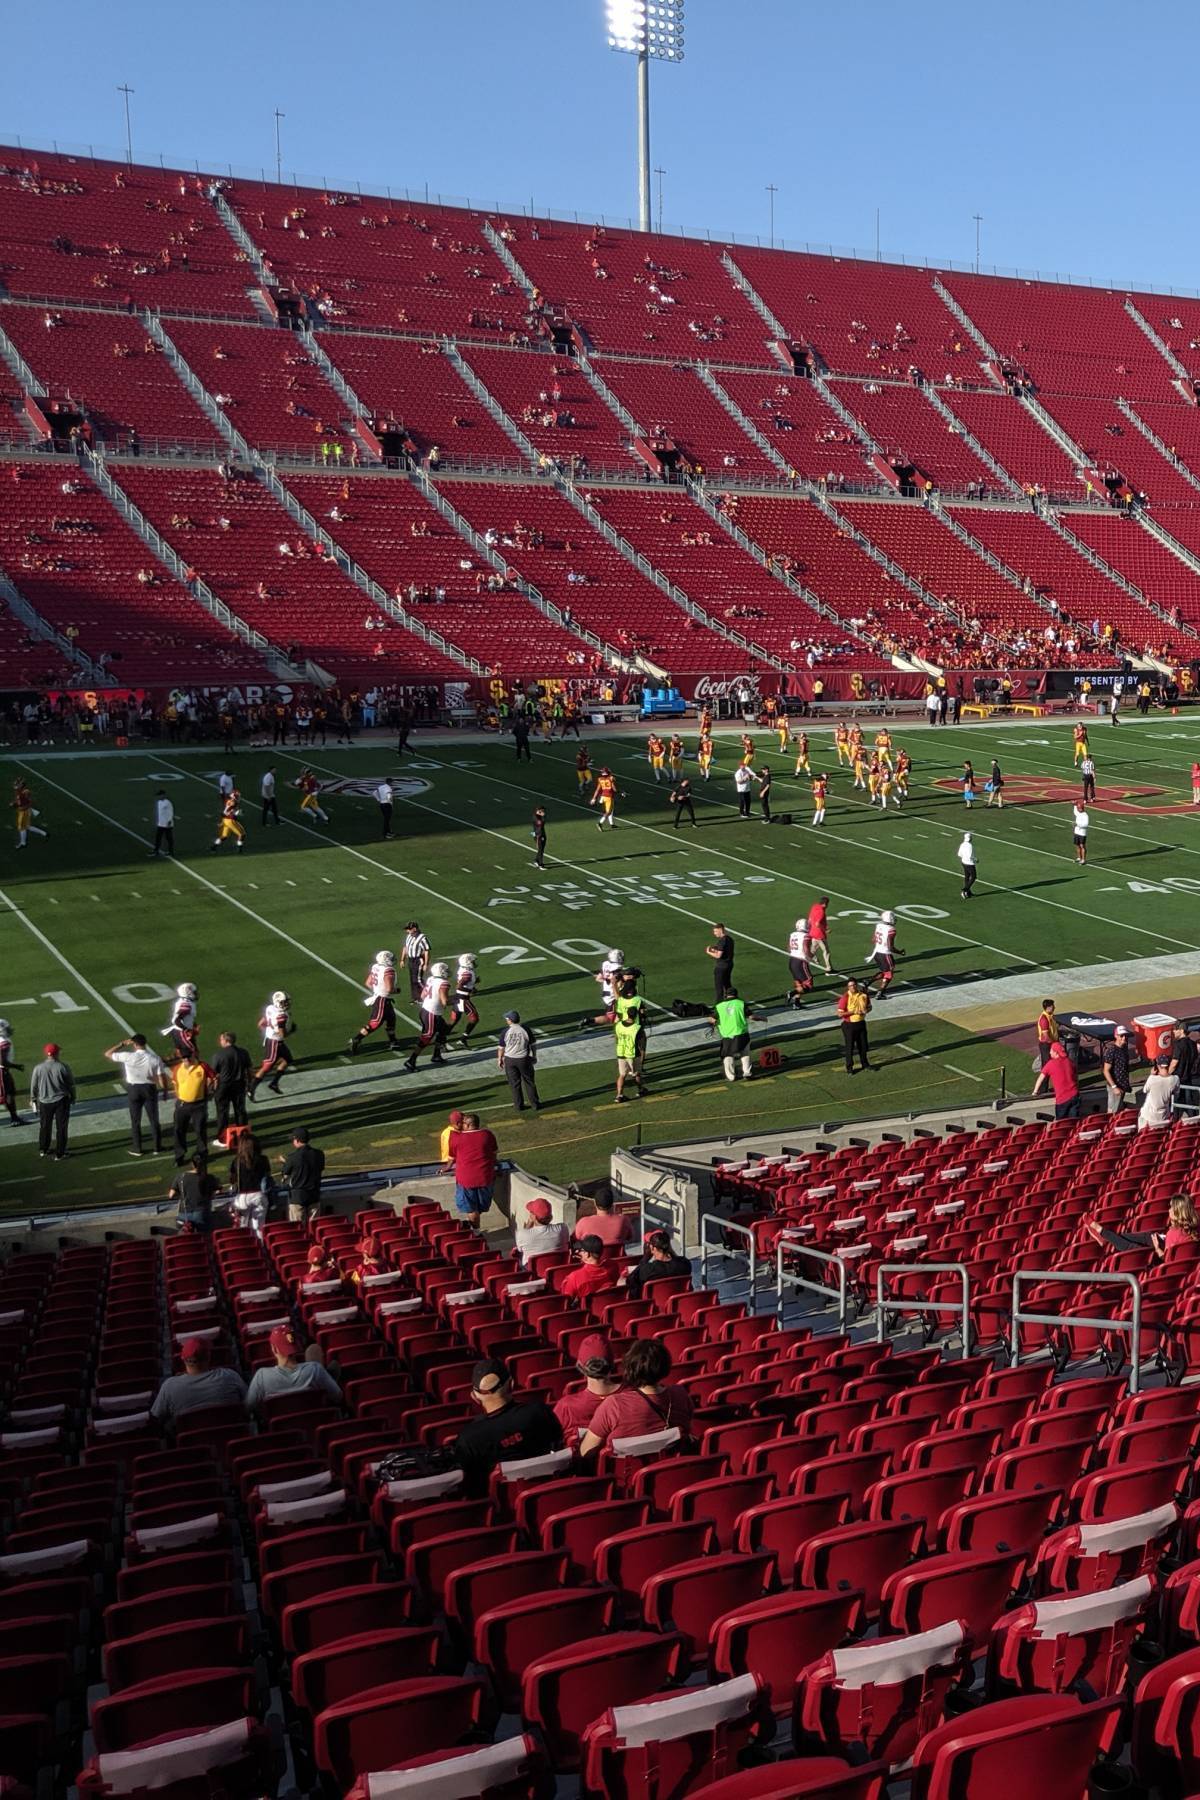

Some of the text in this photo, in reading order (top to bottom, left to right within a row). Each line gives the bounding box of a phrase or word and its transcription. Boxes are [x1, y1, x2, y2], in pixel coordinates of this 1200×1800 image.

[1074, 676, 1139, 686] PRESENTED BY
[837, 904, 951, 925] 30
[479, 938, 613, 965] 20
[41, 983, 177, 1013] 10
[764, 1051, 779, 1065] 20
